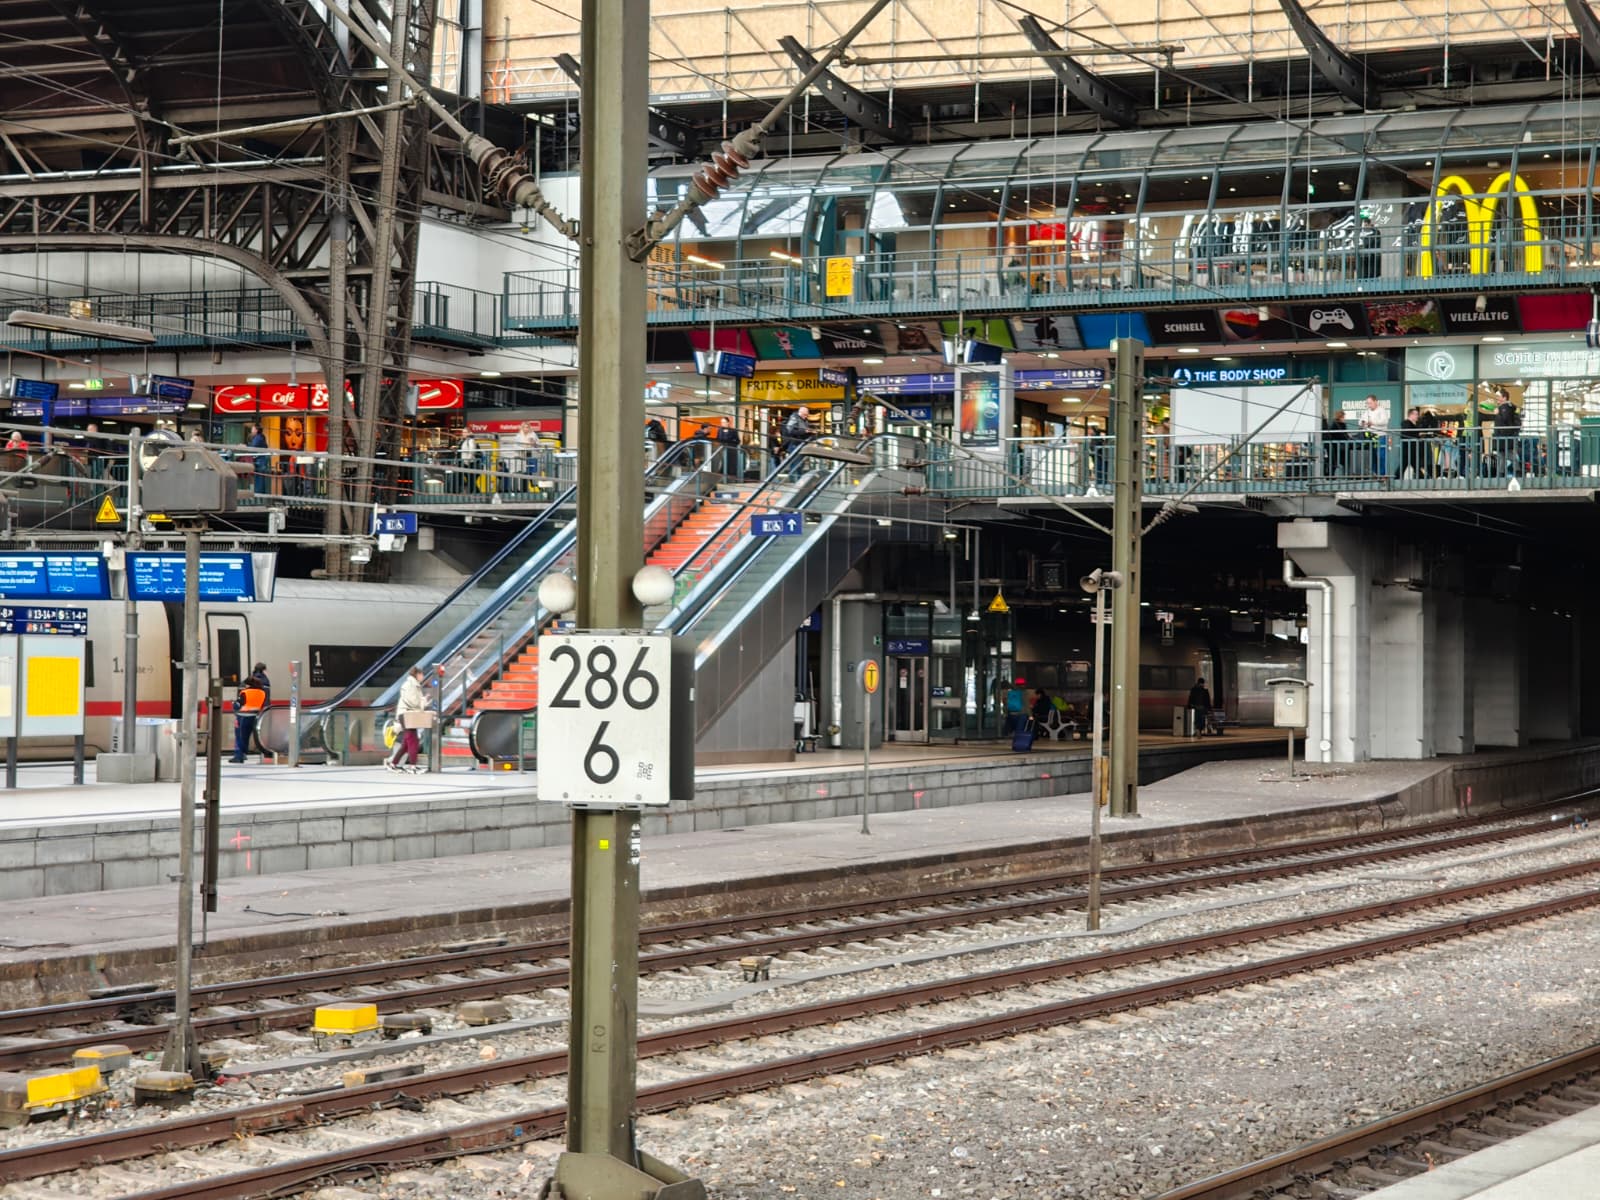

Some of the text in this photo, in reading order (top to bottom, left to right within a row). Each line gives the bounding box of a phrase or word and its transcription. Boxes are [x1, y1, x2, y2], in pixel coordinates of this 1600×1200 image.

[1164, 323, 1206, 333] SCHNELL
[833, 340, 867, 349] WITZIG
[1194, 368, 1286, 381] THE BODY SHOP
[748, 379, 785, 391] FRITTS
[787, 380, 795, 390] &
[272, 391, 295, 404] Café
[34, 610, 51, 619] 13-14
[314, 651, 322, 667] 1
[548, 644, 660, 710] 286
[584, 720, 620, 785] 6
